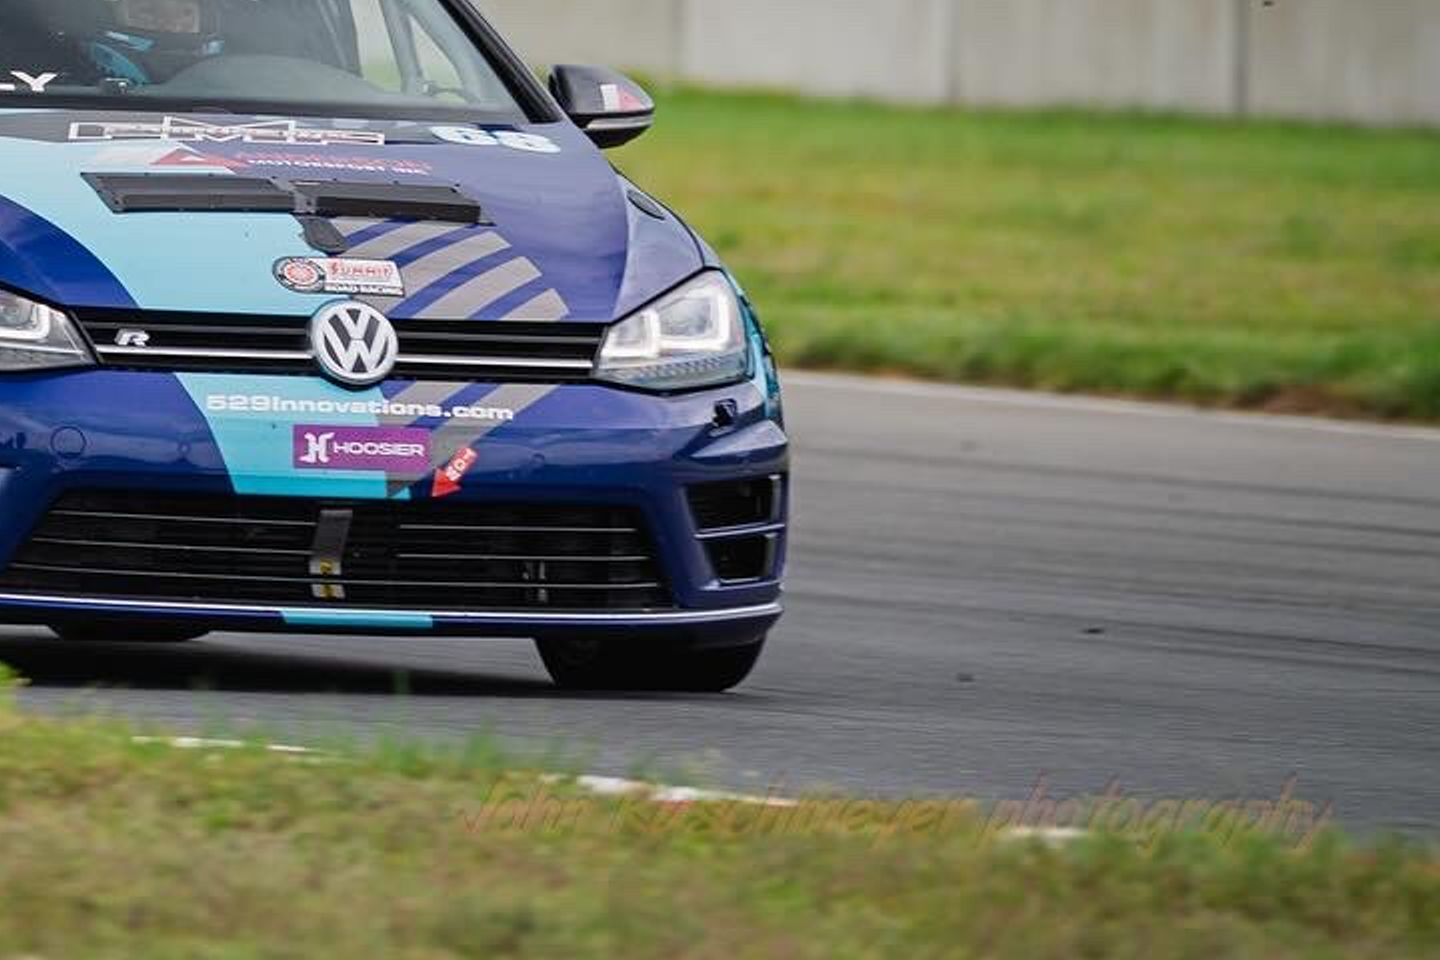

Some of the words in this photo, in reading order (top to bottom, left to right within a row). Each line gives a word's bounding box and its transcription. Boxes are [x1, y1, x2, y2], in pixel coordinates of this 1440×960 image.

[429, 124, 562, 154] 68
[114, 328, 150, 347] R
[206, 394, 514, 420] 529Innovations.com
[333, 441, 426, 457] HOOSIER
